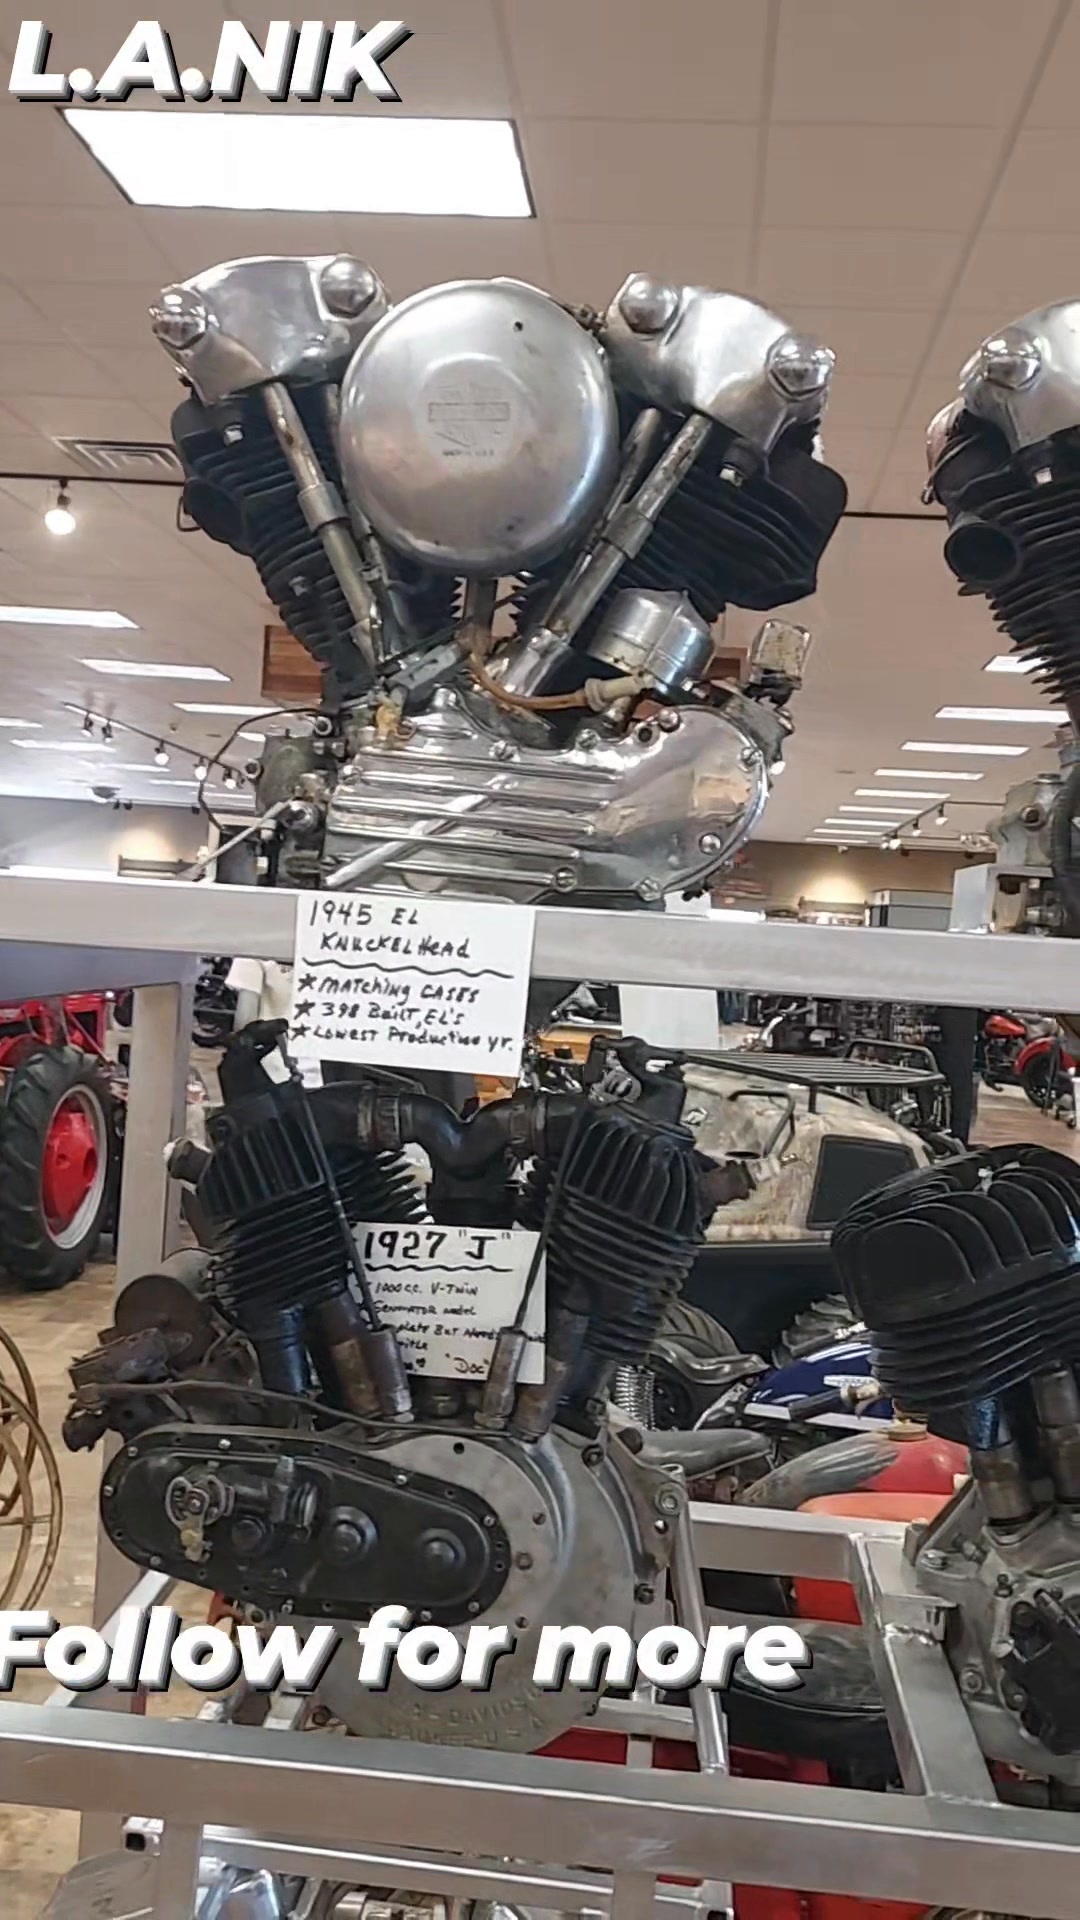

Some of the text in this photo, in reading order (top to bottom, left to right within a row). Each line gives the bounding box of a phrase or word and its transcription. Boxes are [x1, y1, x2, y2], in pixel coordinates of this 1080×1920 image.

[310, 899, 418, 926] 1945 EL
[322, 1003, 360, 1019] 398
[364, 1231, 447, 1259] 1927
